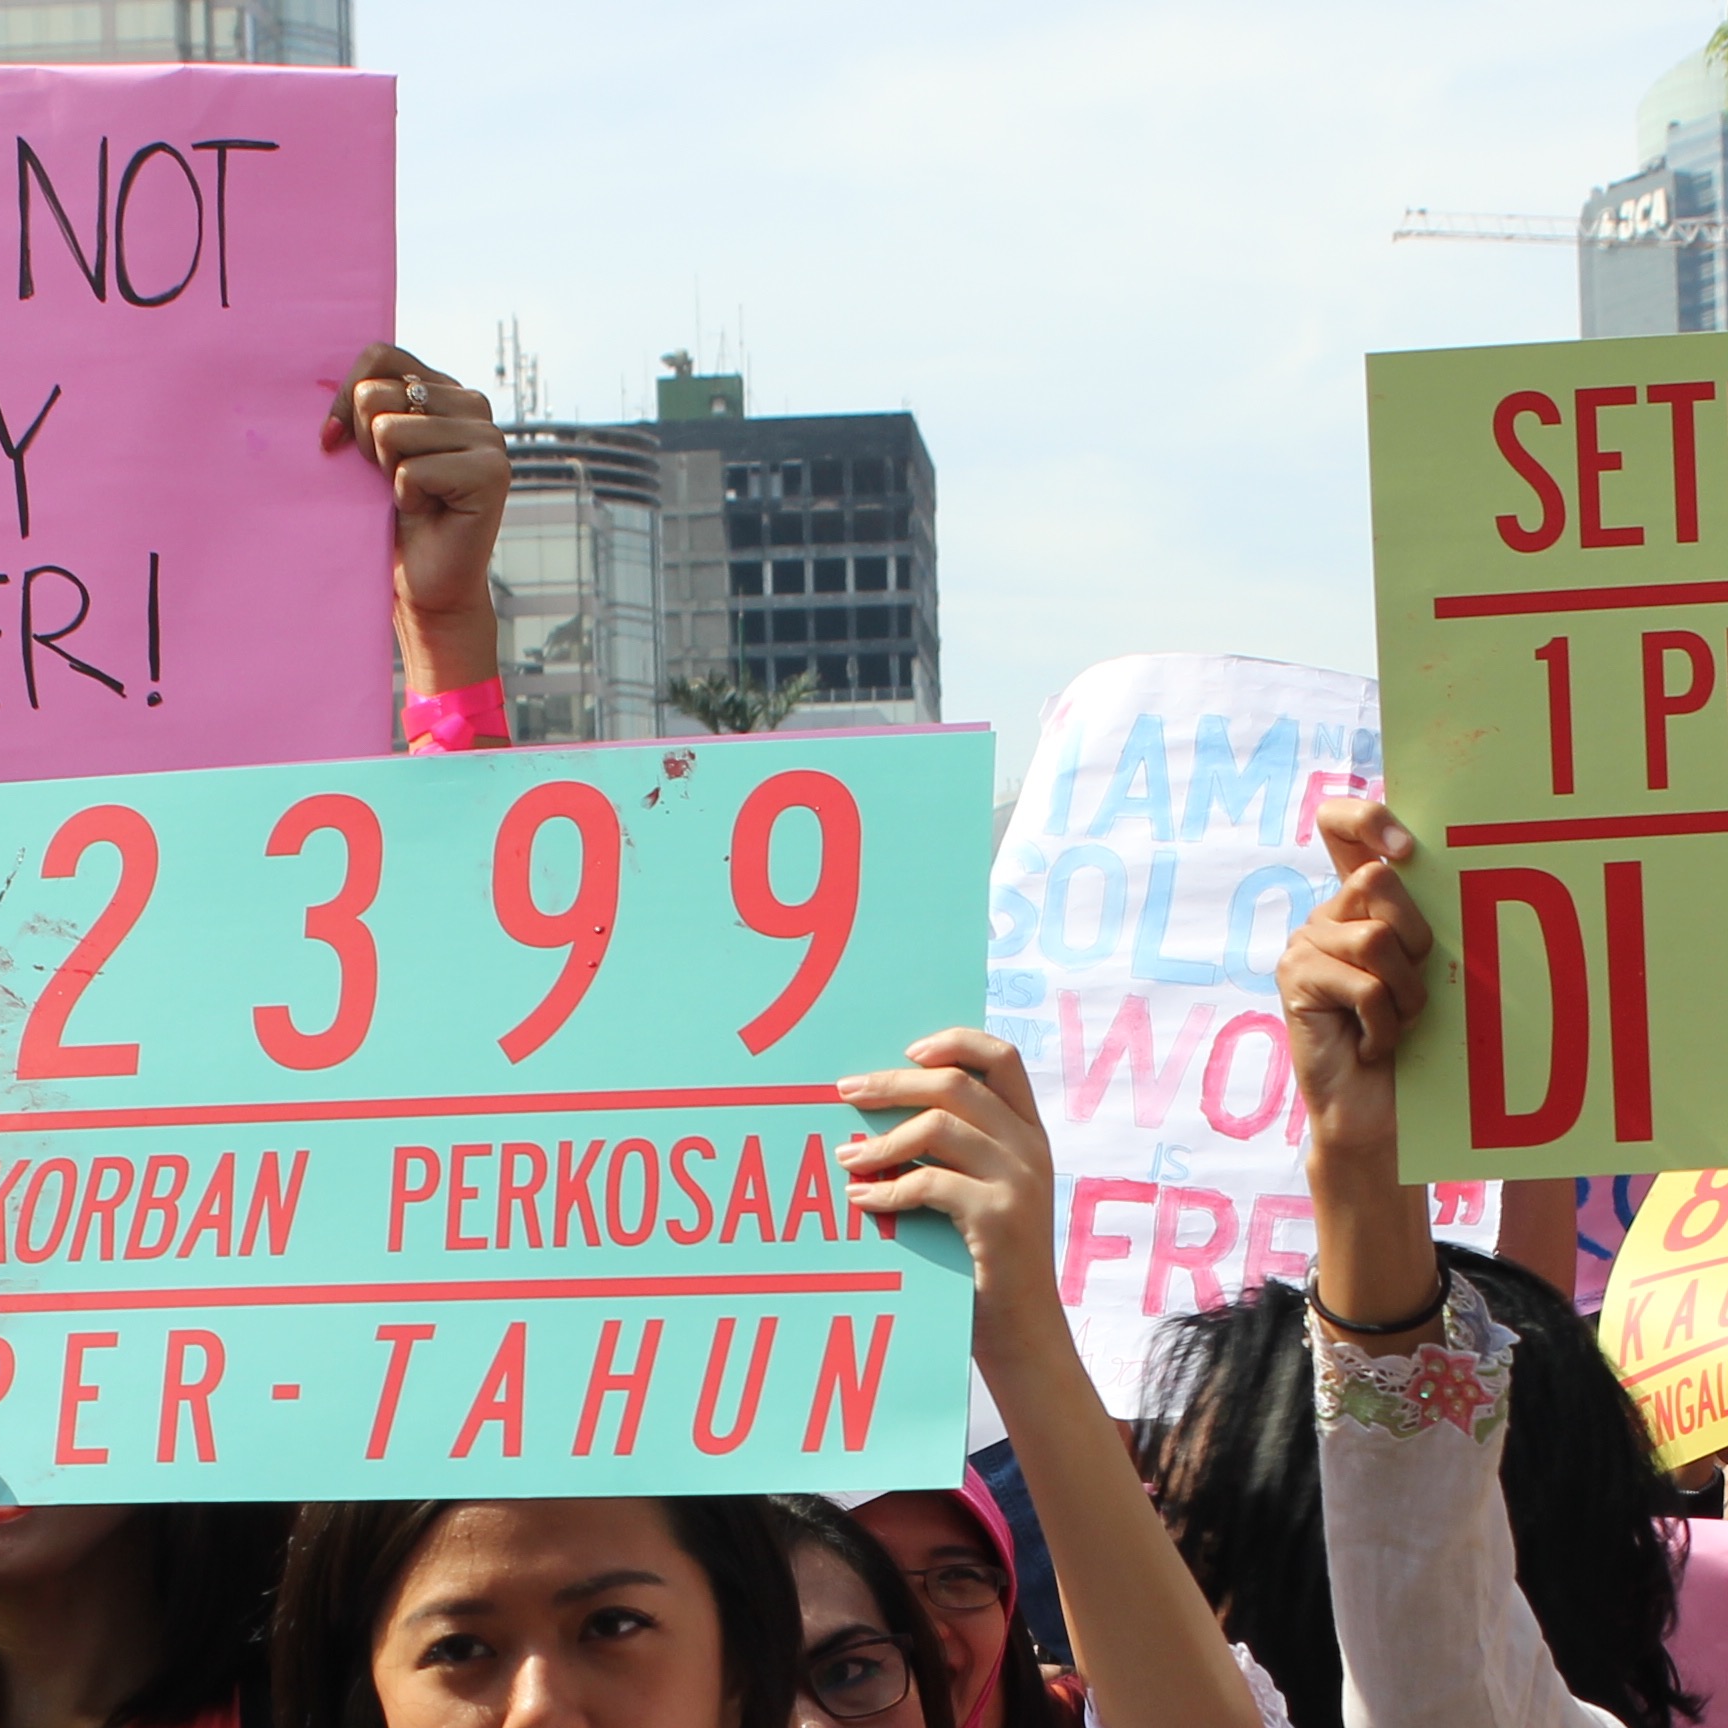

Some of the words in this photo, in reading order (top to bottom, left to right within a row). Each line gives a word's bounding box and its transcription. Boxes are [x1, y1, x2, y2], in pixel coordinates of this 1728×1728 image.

[16, 135, 280, 309] NOT
[1534, 636, 1575, 795] 1
[1459, 860, 1654, 1150] DI
